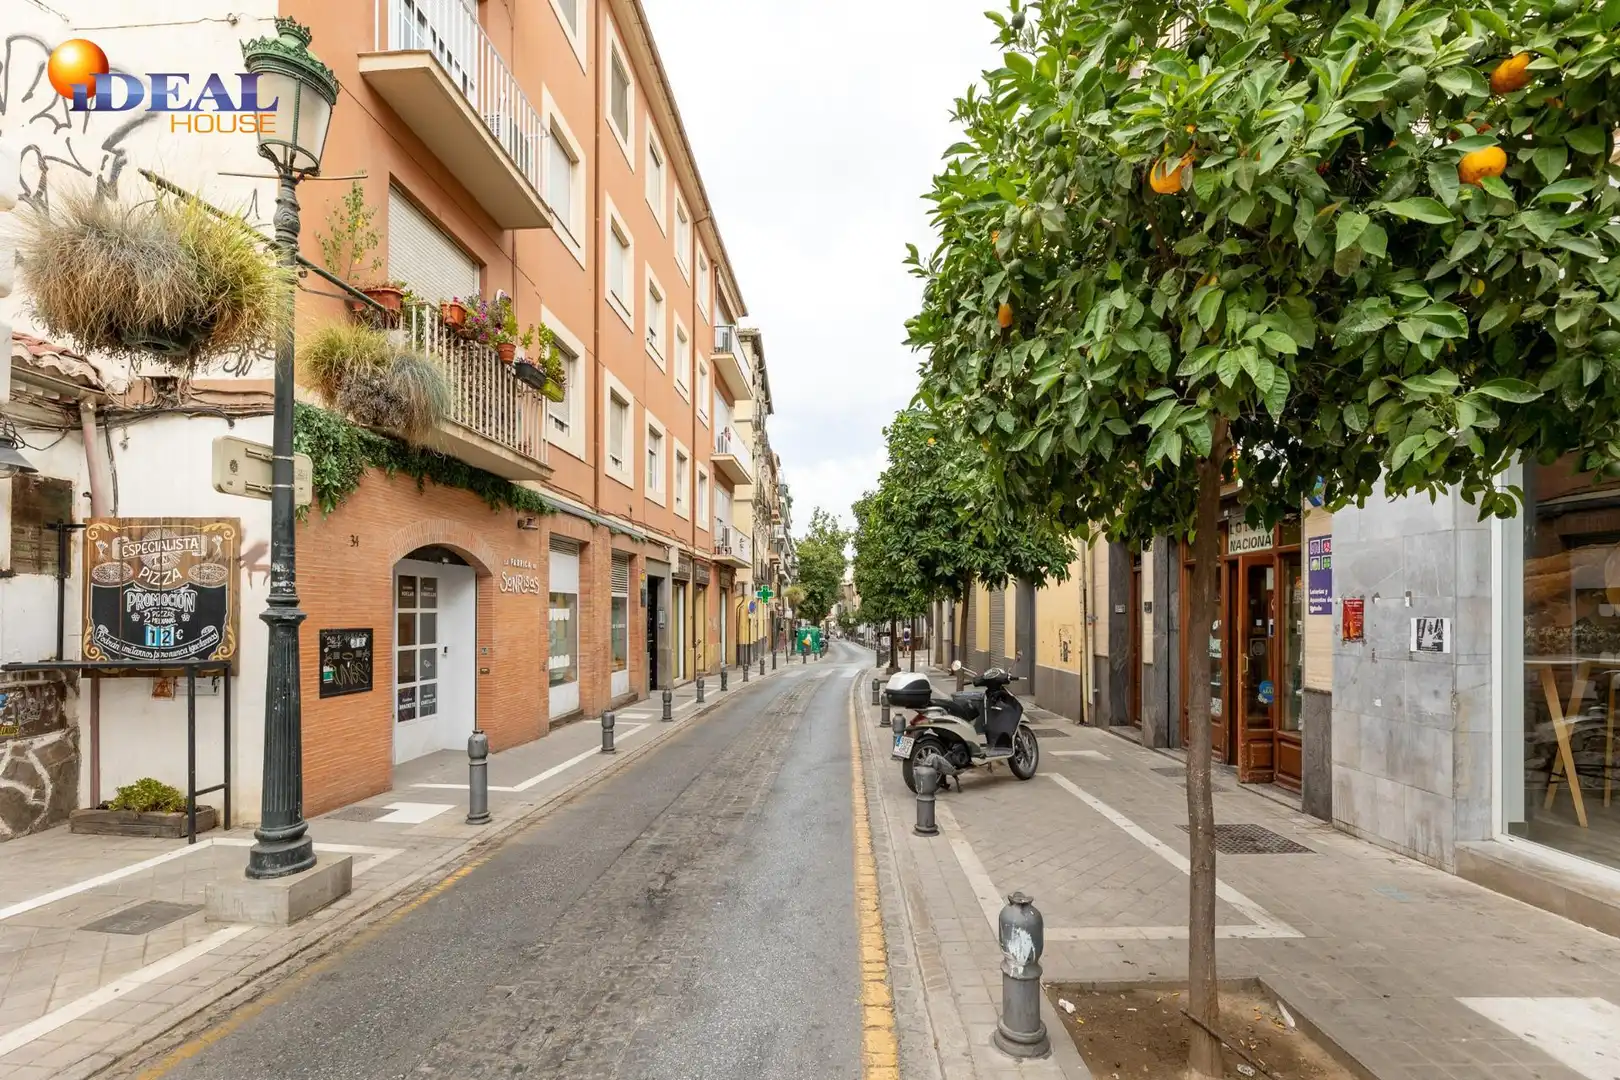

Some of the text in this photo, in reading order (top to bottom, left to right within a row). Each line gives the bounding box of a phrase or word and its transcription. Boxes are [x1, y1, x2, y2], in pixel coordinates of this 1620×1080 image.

[122, 537, 199, 557] ESPECIALISTA
[350, 534, 359, 547] 34
[1230, 534, 1272, 552] NACIONA
[138, 566, 183, 586] PIZZA
[143, 611, 151, 624] 2
